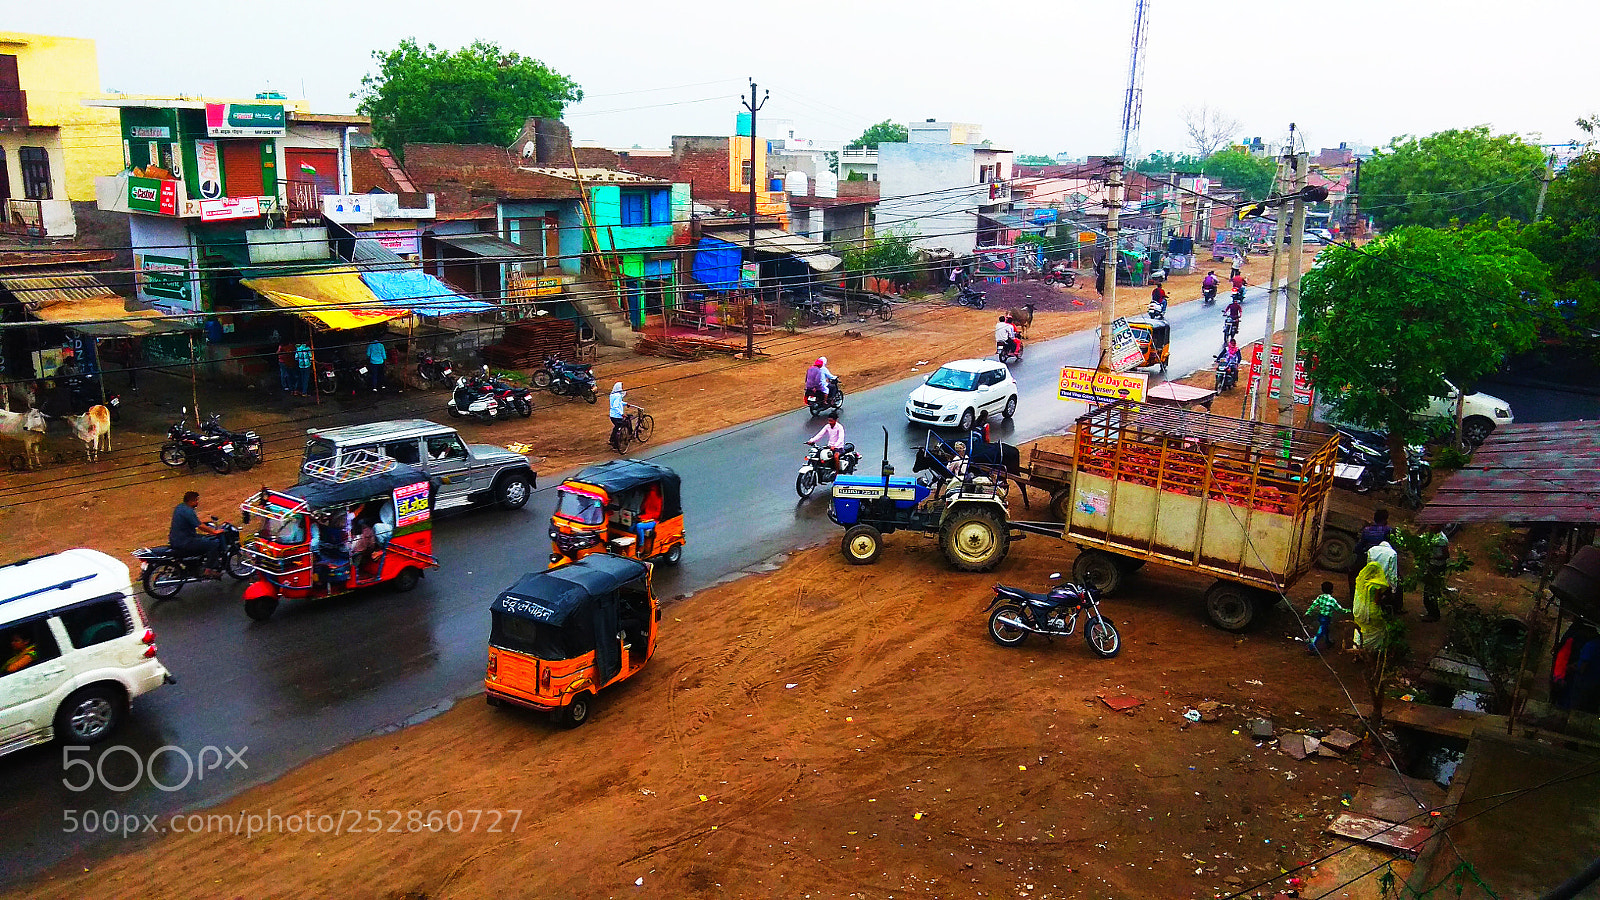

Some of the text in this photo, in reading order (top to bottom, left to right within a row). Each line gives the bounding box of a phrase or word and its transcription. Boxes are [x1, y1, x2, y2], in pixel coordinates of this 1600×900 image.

[198, 142, 217, 180] Castrol
[137, 188, 156, 200] Castrol
[1062, 370, 1077, 379] K.L.
[1098, 375, 1104, 383] &
[1106, 377, 1121, 387] Day
[1123, 379, 1141, 389] Care
[1071, 382, 1083, 390] Play
[1093, 386, 1115, 395] Nursery
